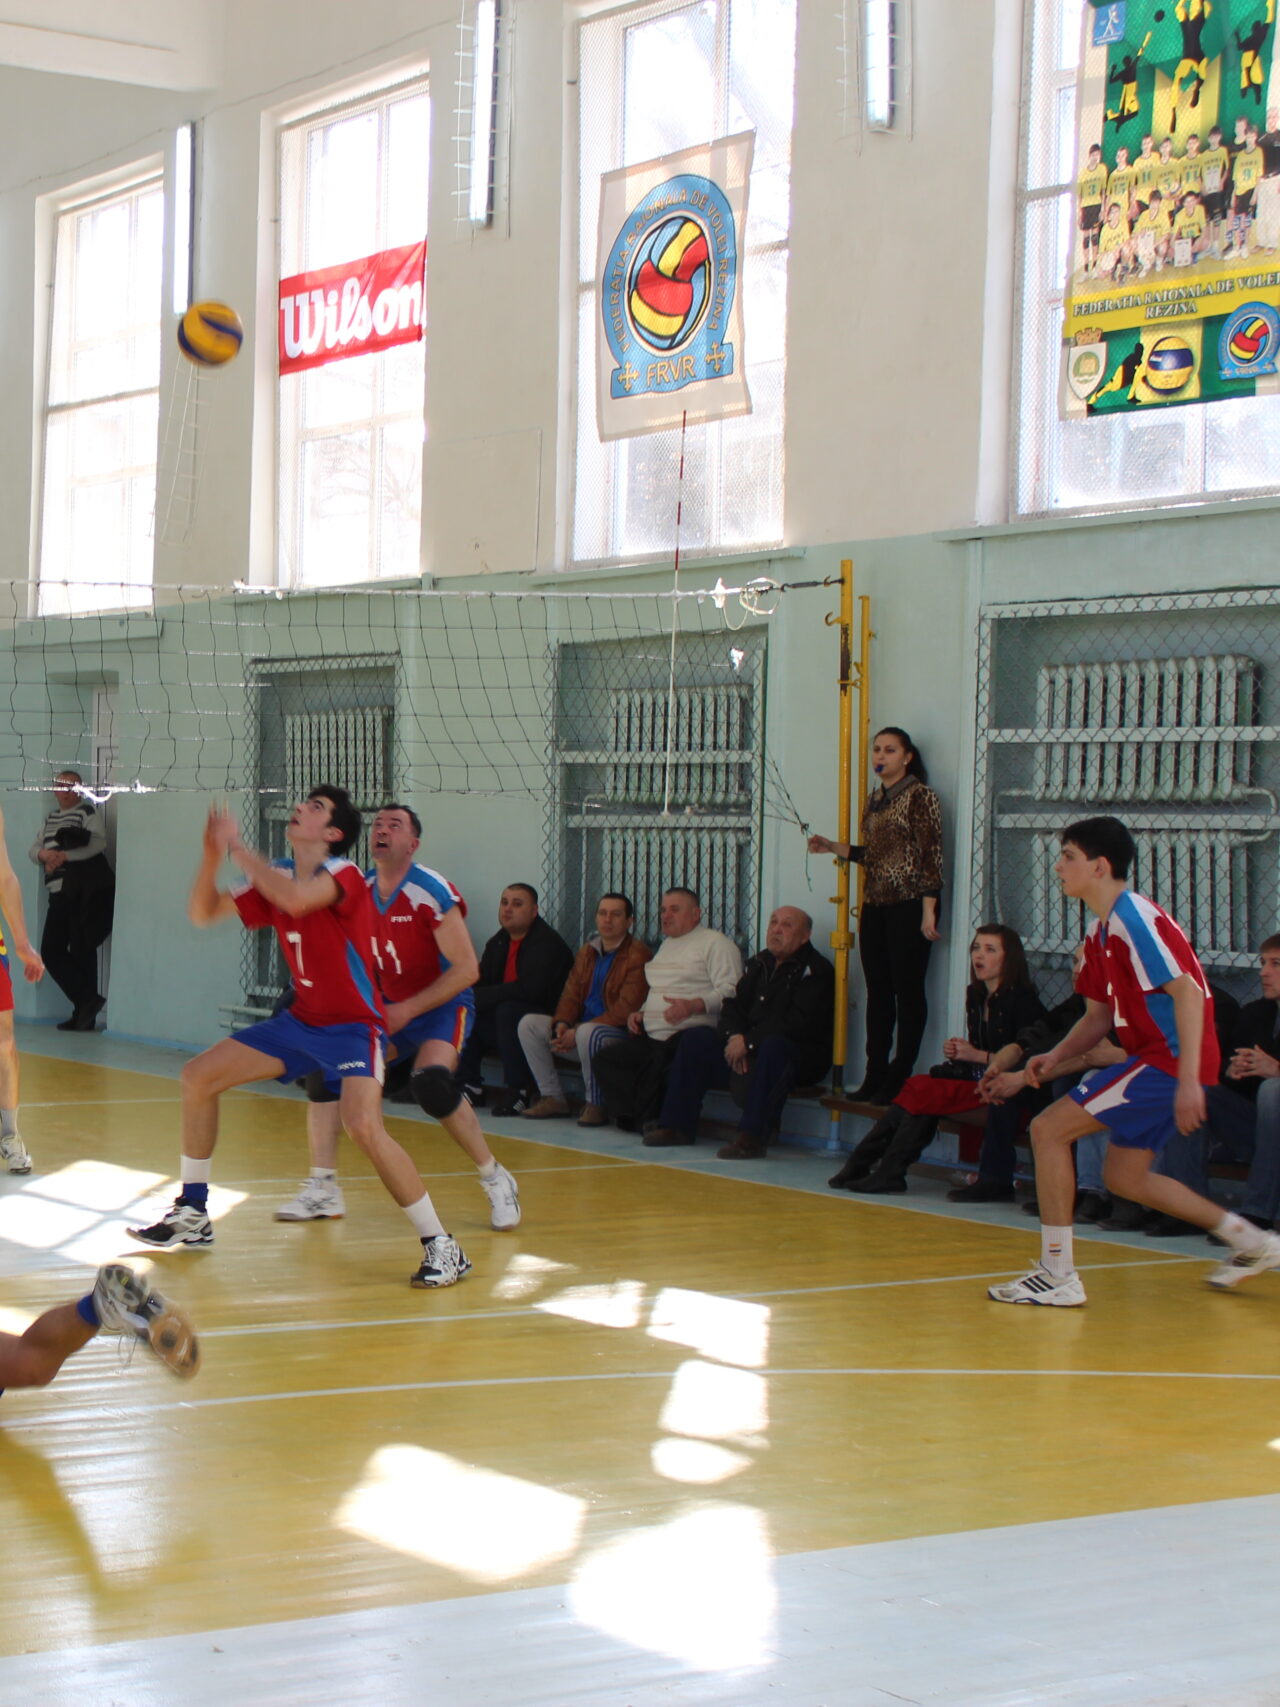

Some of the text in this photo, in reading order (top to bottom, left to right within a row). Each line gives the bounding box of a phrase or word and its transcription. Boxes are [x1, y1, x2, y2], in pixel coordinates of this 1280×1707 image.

[610, 188, 730, 352] FEDERATIA RAIONALA DE VOLEI REZINA
[1073, 270, 1280, 317] FEDERATIA RAIONALA DE VOLEI
[280, 276, 425, 359] Wilson
[1145, 300, 1197, 319] REZINA
[646, 356, 696, 386] FRVR
